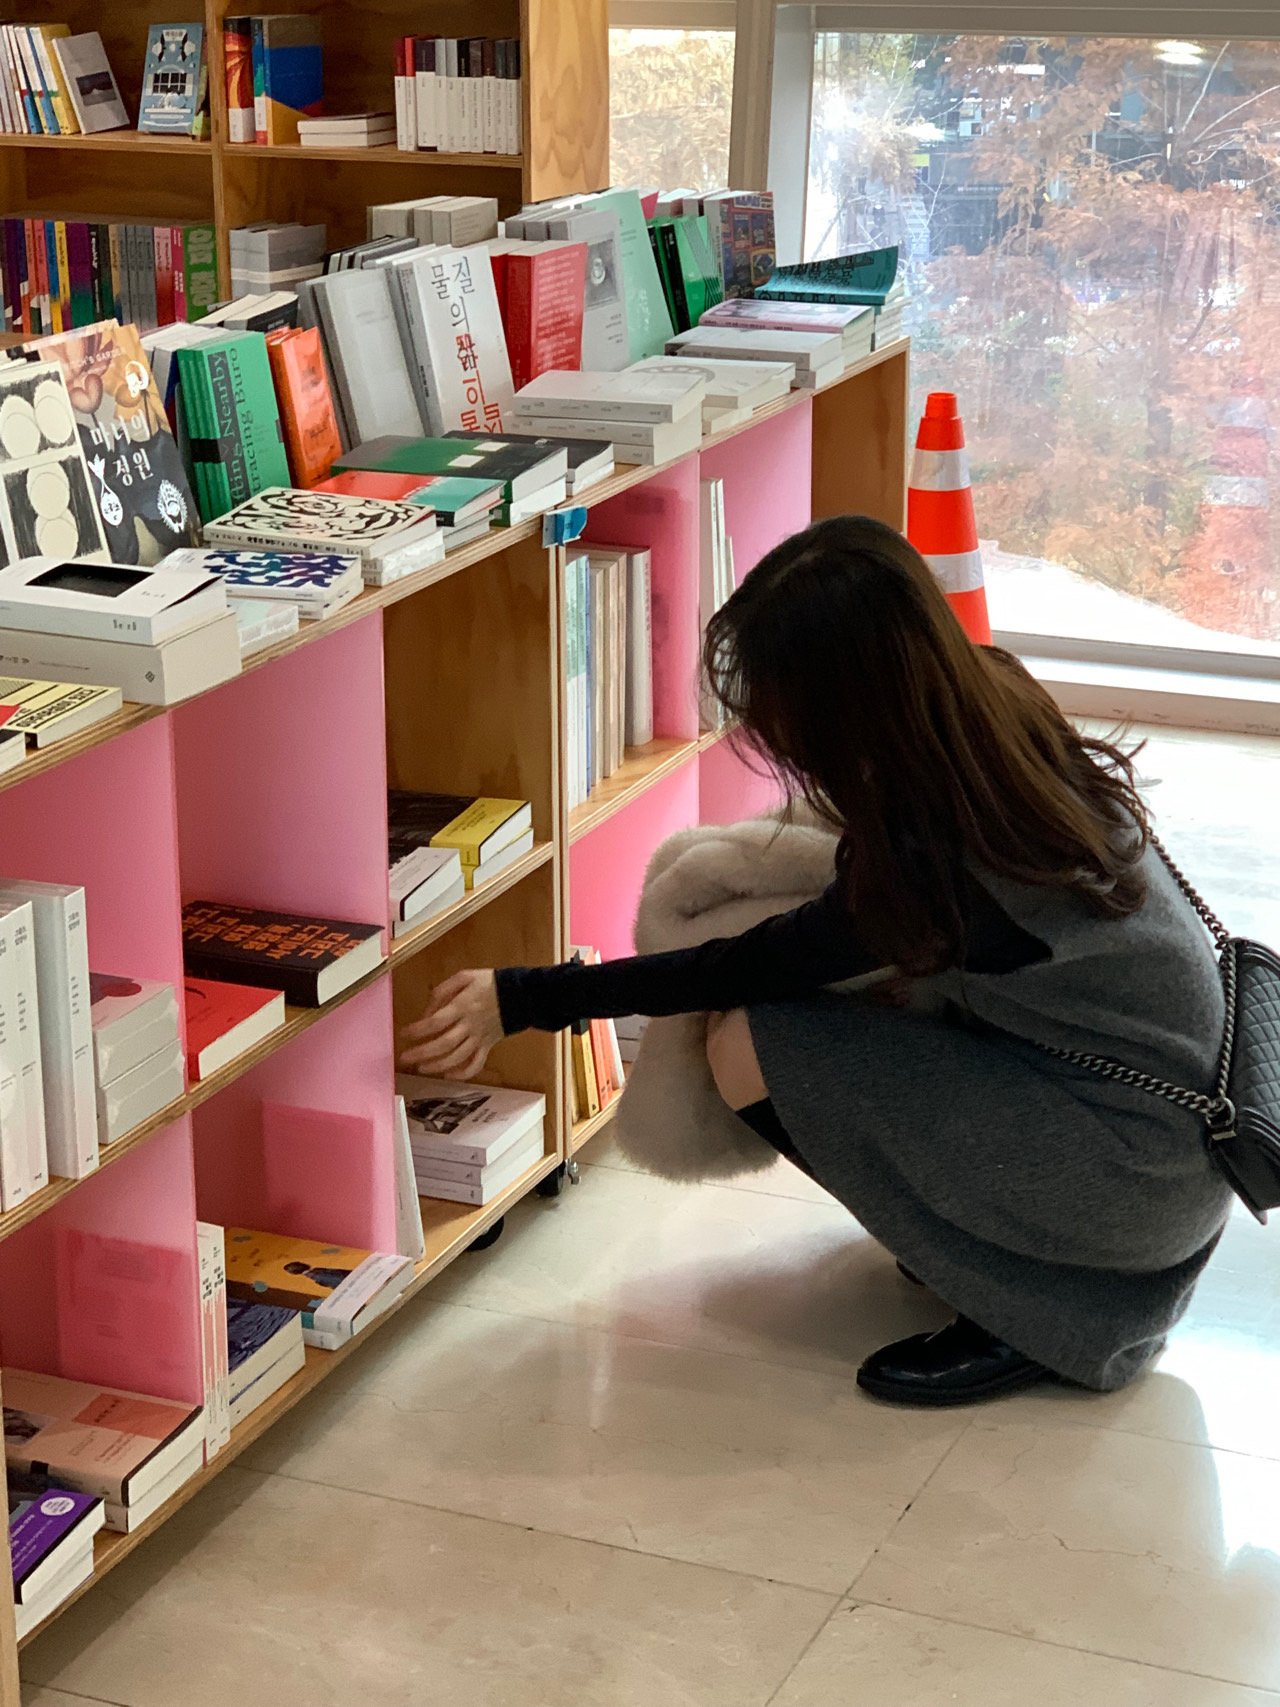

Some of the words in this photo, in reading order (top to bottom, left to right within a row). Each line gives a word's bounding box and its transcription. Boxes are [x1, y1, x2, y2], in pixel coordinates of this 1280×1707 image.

[213, 354, 236, 438] Nearby
[231, 348, 246, 406] Buro
[89, 408, 152, 453] 마녀의
[112, 447, 155, 488] 정원
